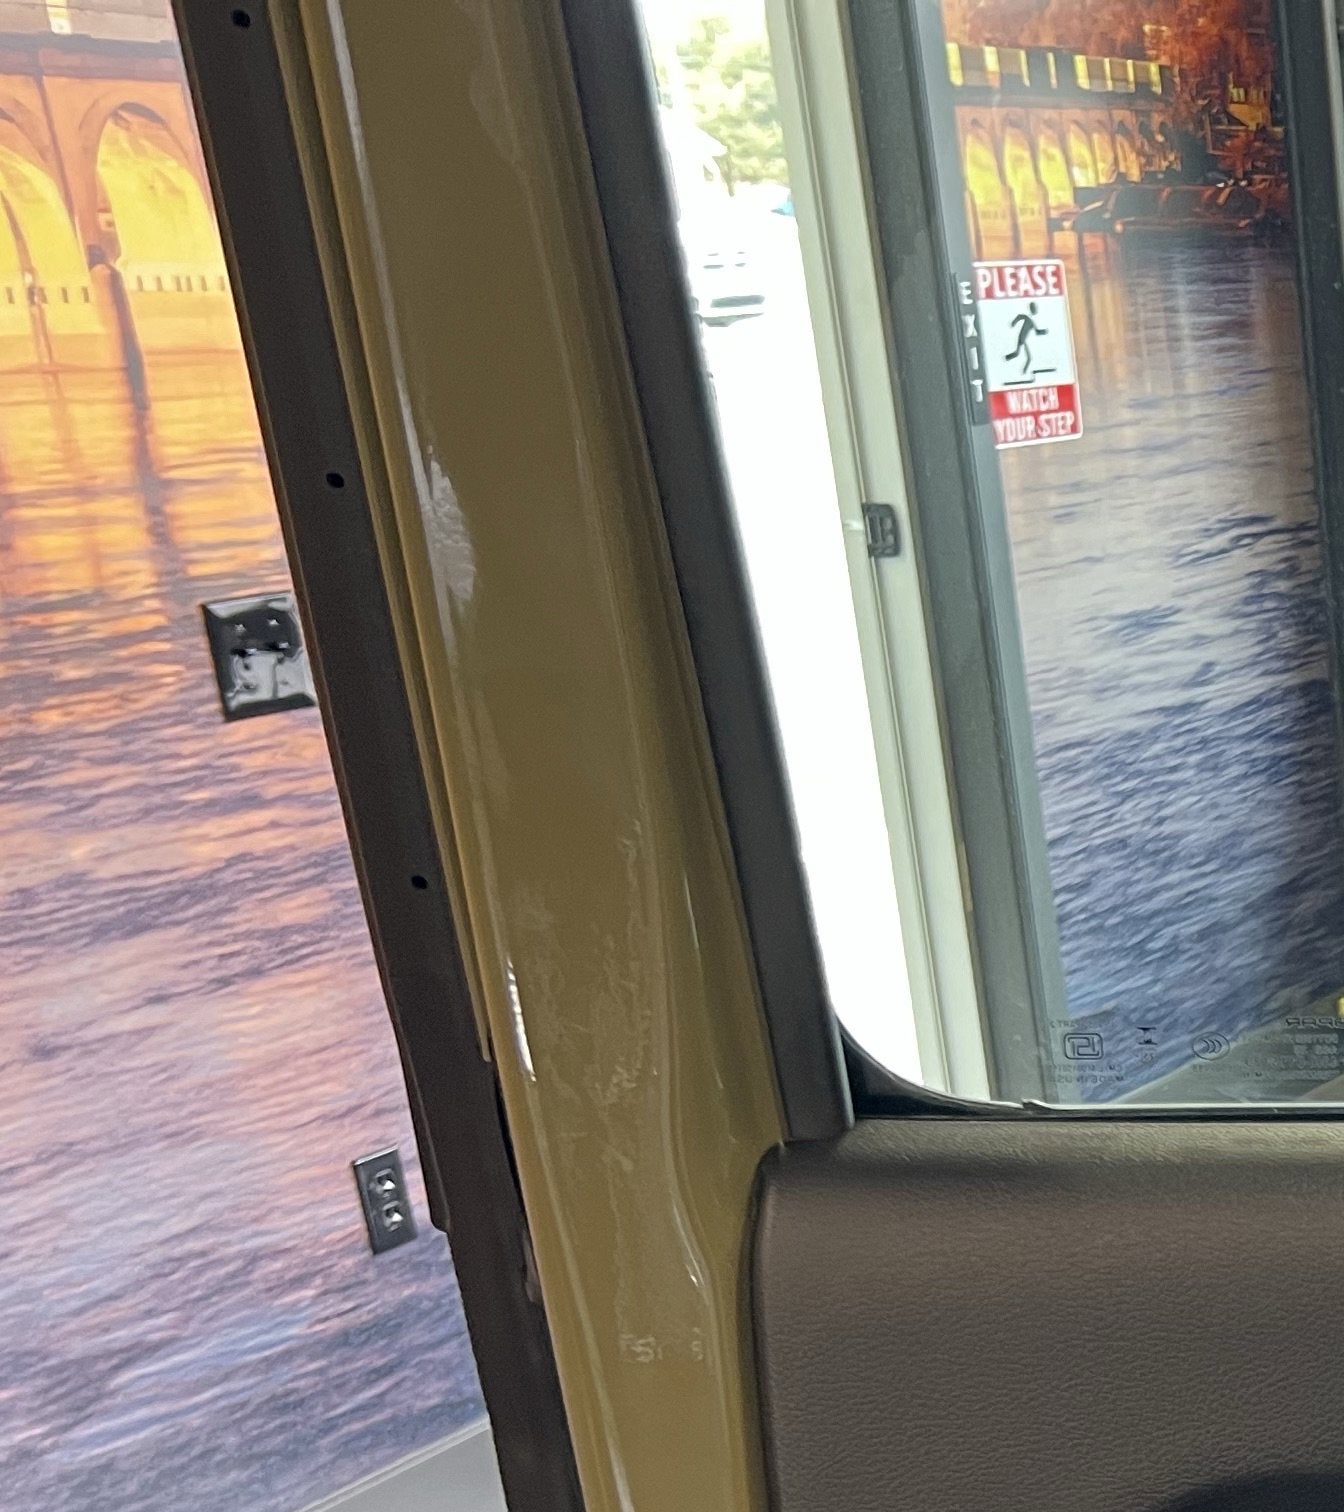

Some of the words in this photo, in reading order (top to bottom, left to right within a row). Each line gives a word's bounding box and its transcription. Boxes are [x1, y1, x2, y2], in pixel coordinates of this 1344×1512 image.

[976, 265, 1060, 300] PLEASE
[959, 281, 984, 402] EXIT
[1006, 386, 1060, 415] WATCH
[993, 415, 1037, 443] YOUR
[1037, 411, 1075, 438] STEP
